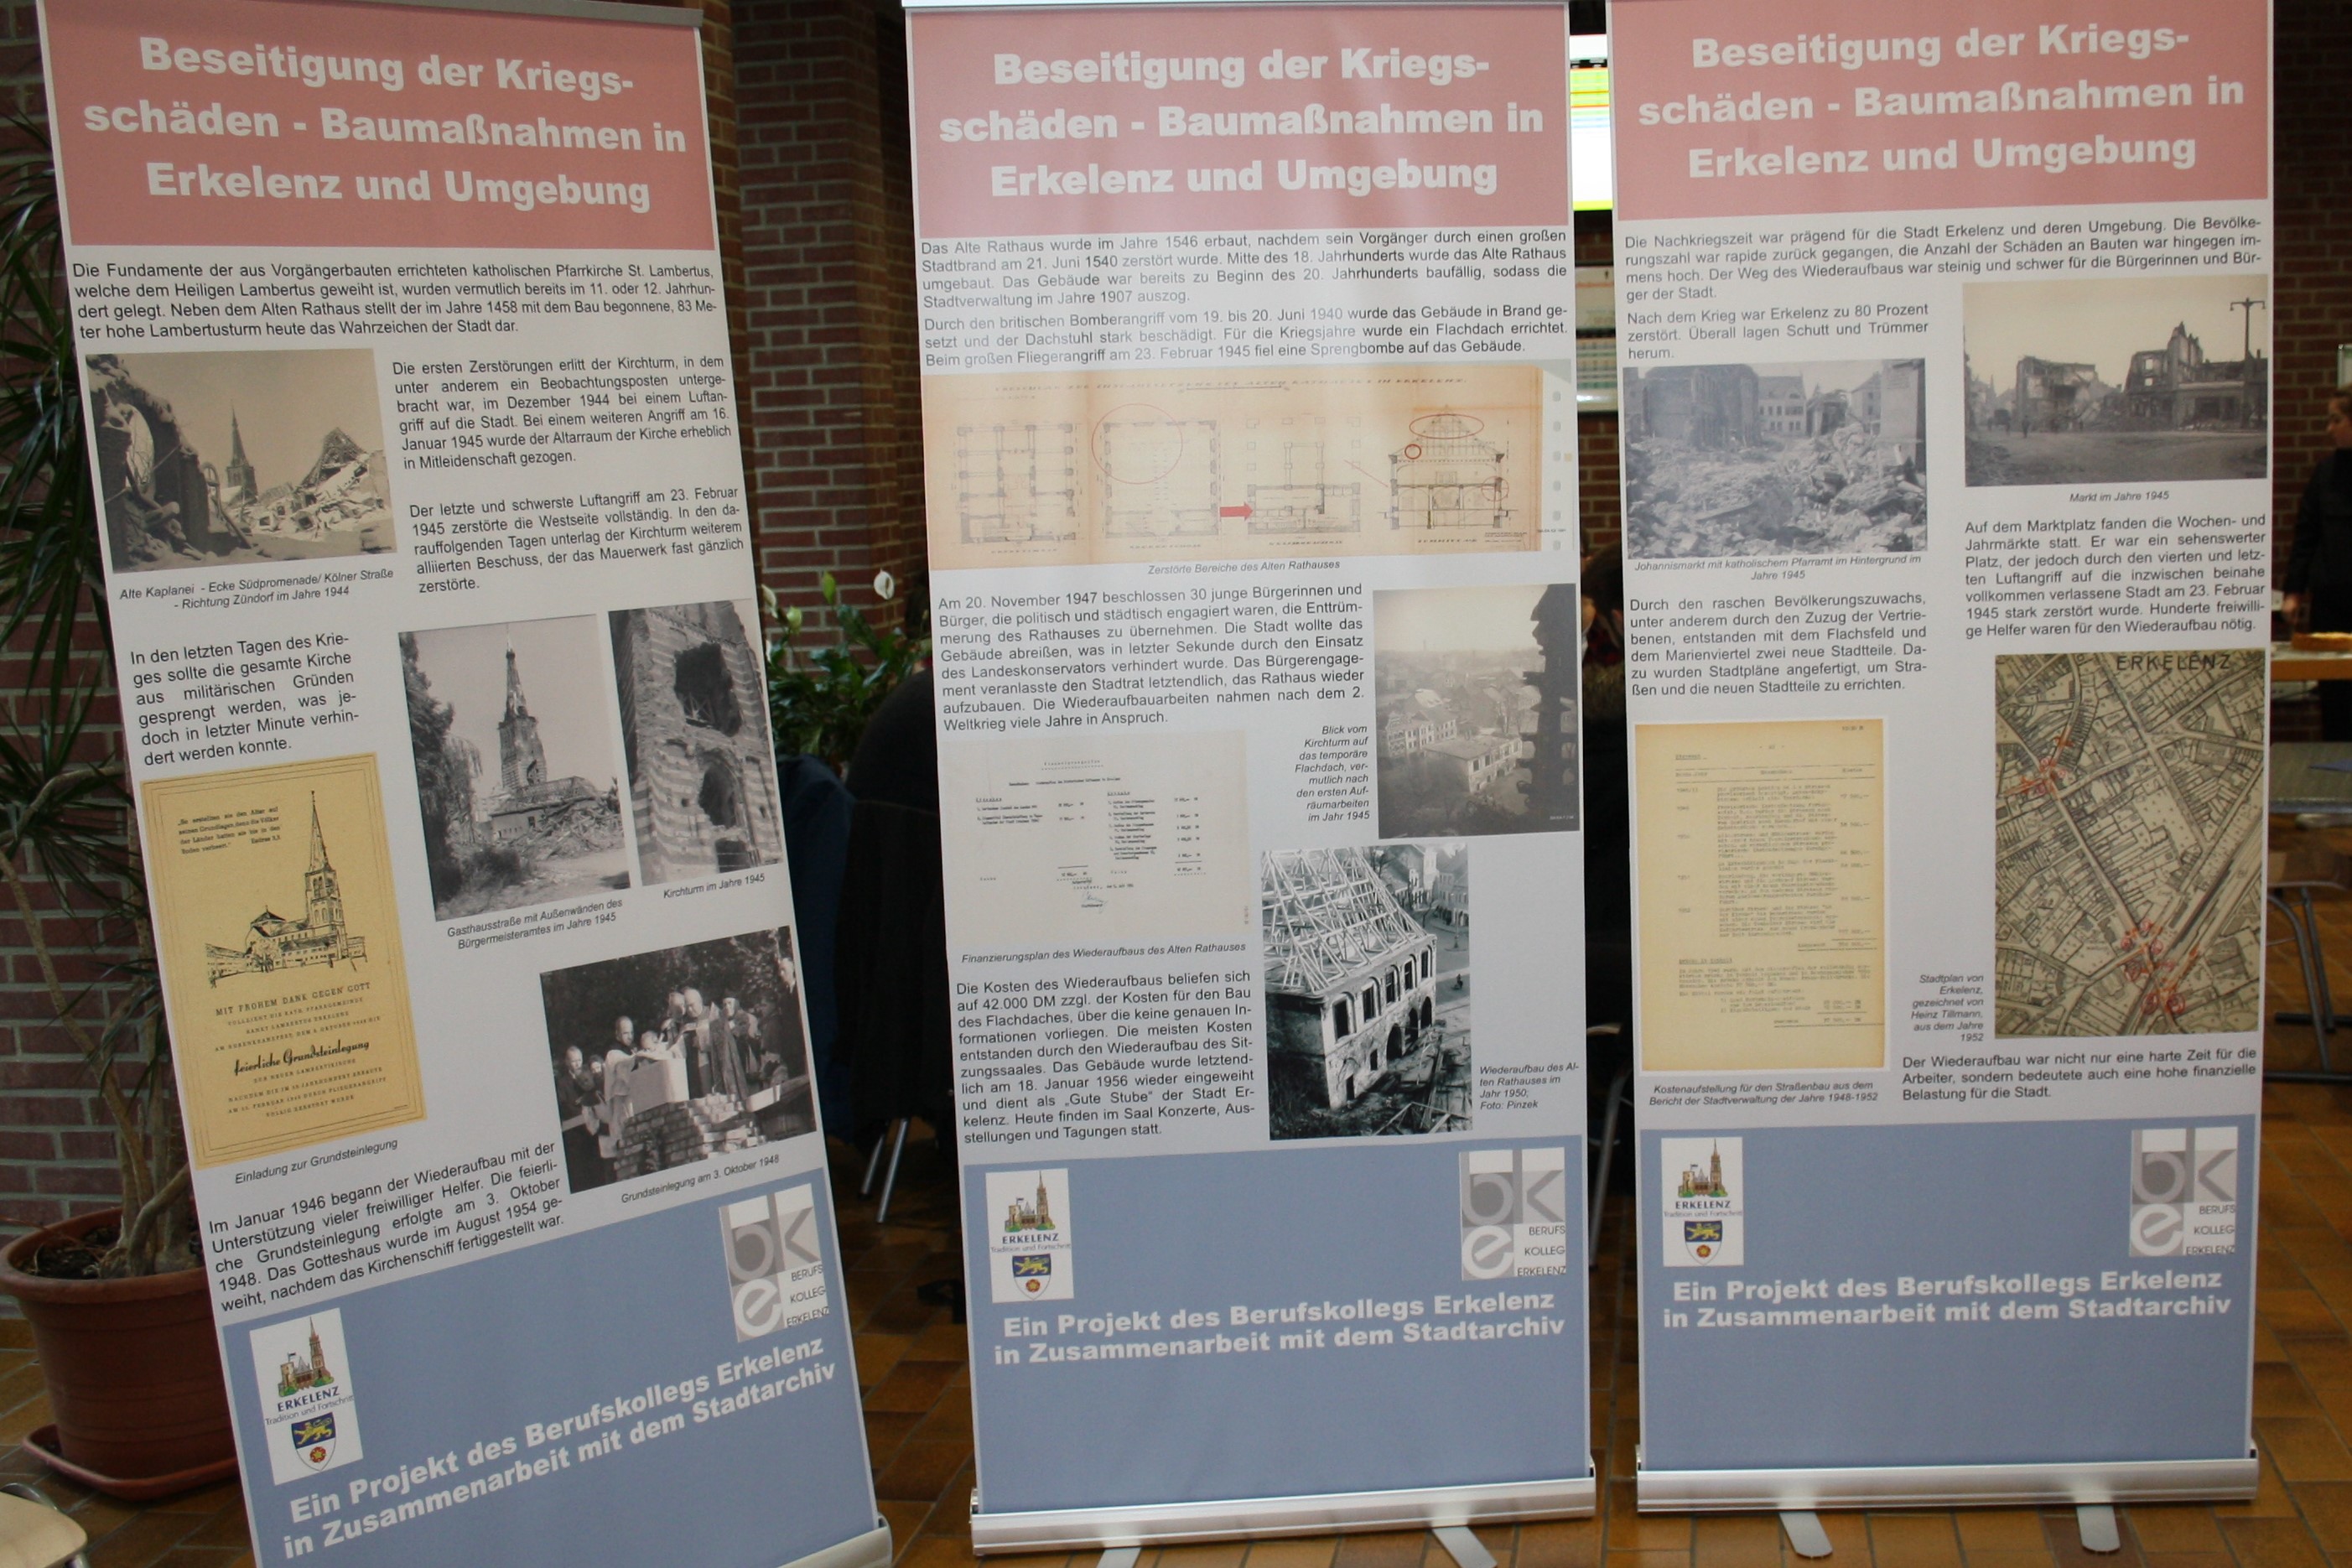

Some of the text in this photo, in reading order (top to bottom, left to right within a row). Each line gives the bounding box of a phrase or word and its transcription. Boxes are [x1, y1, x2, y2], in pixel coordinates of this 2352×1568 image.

[1692, 23, 2189, 70] Beseitigung der Kriegs-
[139, 36, 634, 101] Beseitigung der Kriegs-
[994, 47, 1490, 90] Beseitigung der Kriegs-
[1638, 91, 1814, 126] schäden
[1854, 79, 2193, 117] Baumaßnahmen
[2208, 75, 2244, 105] in
[83, 99, 279, 138] schäden
[320, 106, 642, 151] Baumaßnahmen
[652, 122, 687, 153] in
[939, 107, 1118, 143] schäden
[1158, 101, 1493, 138] Baumaßnahmen
[1507, 101, 1544, 132] in
[1689, 133, 2196, 179] Erkelenz und Umgebung
[146, 162, 651, 214] Erkelenz und Umgebung
[991, 156, 1498, 202] Erkelenz und Umgebung
[1625, 215, 2261, 249] Die Nachkriegszeit war prägend für die Stadt Erkelenz und deren Umgebung. Die Bevölke-
[72, 262, 714, 281] Die Fundamente der aus Vorgängerbauten errichteten katholischen Pfarrkirche St. Lambertus,
[2069, 493, 2098, 502] Markt
[2113, 491, 2142, 501] Jahre
[2146, 490, 2170, 501] 1945
[1965, 513, 2266, 534] Auf dem Marktplatz fanden die Wochen- und
[119, 588, 143, 600] Alte
[145, 583, 195, 599] Kaplanei
[208, 580, 236, 593] Ecke
[238, 574, 322, 591] Südpromenade/
[324, 572, 357, 584] Kölner
[360, 568, 394, 581] Straße
[937, 583, 1362, 610] Am 20. November 1947 beschlossen 30 junge Bürgerinnen und
[2116, 653, 2232, 671] ERKELENZ
[663, 872, 766, 899] Kirchturm im Jahre 1945
[961, 943, 1247, 963] Finanzierungsplan des Wiederaufbaus des Alten Rathauses
[233, 1052, 281, 1077] feierliche
[283, 1039, 370, 1065] Grundsteinlegung
[235, 1140, 398, 1185] Einladung zur Grundsteinlegung
[620, 1154, 780, 1203] Grundsteinlegung am 3. Oktober 1948
[209, 1142, 555, 1234] Im Januar 1946 begann der Wiederaufbau mit der
[1674, 1200, 1731, 1210] ERKELENZ
[2199, 1204, 2235, 1214] BERUFS
[1002, 1233, 1059, 1244] ERKELENZ
[1529, 1225, 1565, 1236] BERUFS
[2194, 1225, 2235, 1235] KOLLEG
[1524, 1245, 1565, 1256] KOLLEG
[2186, 1245, 2235, 1255] ERKELENZ
[791, 1265, 823, 1282] BERUFS
[1517, 1266, 1566, 1276] ERKELENZ
[1673, 1269, 2222, 1305] Ein Projekt des Berufskollegs Erkelenz
[790, 1286, 826, 1303] KOLLEG
[1664, 1294, 2232, 1328] in Zusammenarbeit mit dem Stadtarchiv
[787, 1306, 829, 1327] ERKELENZ
[1004, 1291, 1555, 1337] Ein Projekt des Berufskollegs Erkelenz
[994, 1316, 1565, 1365] in Zusammenarbeit mit dem Stadtarchiv
[277, 1385, 340, 1413] ERKELENZ
[289, 1337, 824, 1524] Ein Projekt des Berufskollegs Erkelenz
[283, 1362, 835, 1560] in Zusammenarbeit mit dem Stadtarchiv
